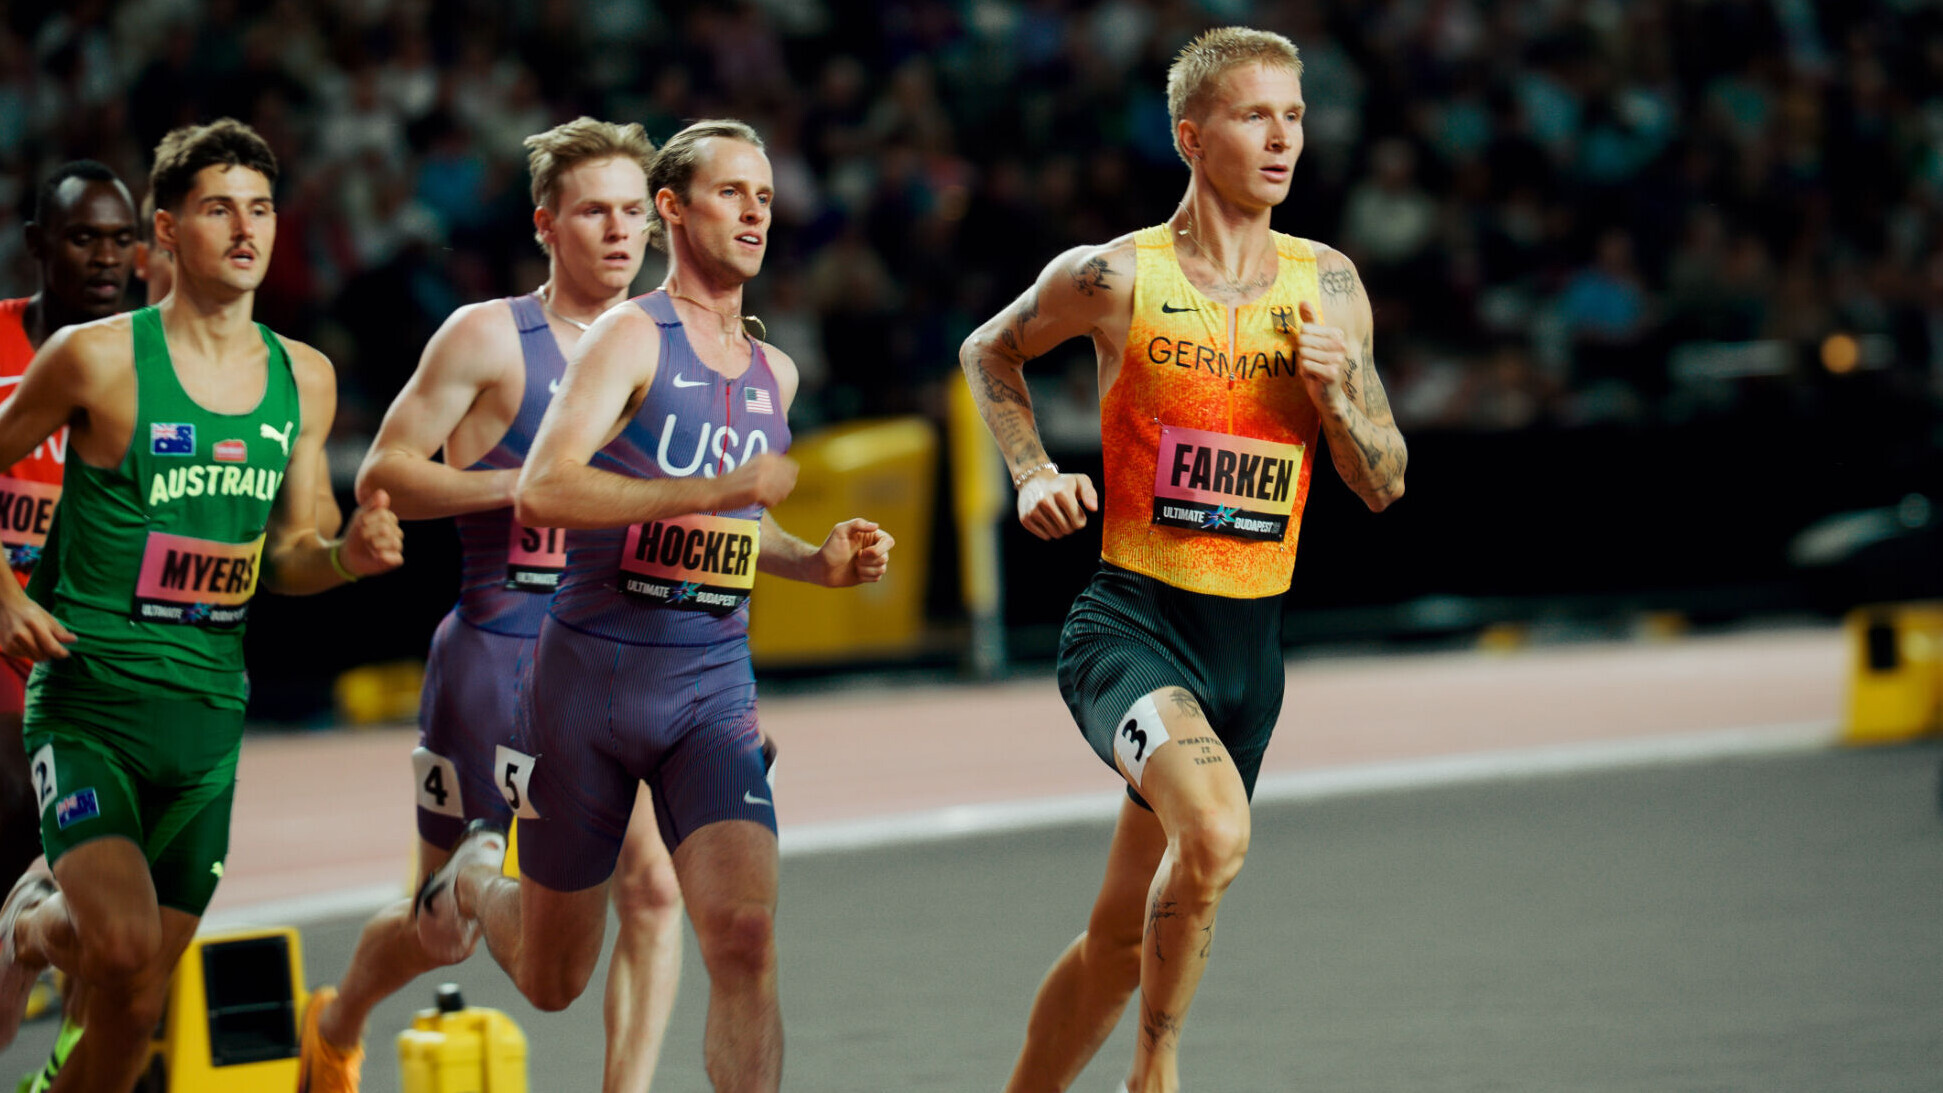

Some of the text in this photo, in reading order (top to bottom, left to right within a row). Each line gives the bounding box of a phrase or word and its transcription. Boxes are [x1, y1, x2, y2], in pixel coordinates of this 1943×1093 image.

[1148, 335, 1297, 380] GERMAN
[1170, 443, 1294, 502] FARKEN
[1163, 506, 1205, 523] ULTIMATE
[1234, 517, 1274, 533] BUDAPEST
[635, 521, 752, 576] HOCKER
[160, 549, 256, 594] MYERS
[626, 579, 670, 599] ULTIMATE
[695, 591, 737, 607] BUDAPEST
[1121, 718, 1148, 762] 3
[35, 761, 52, 806] 2
[424, 765, 448, 807] 4
[505, 762, 520, 809] 5
